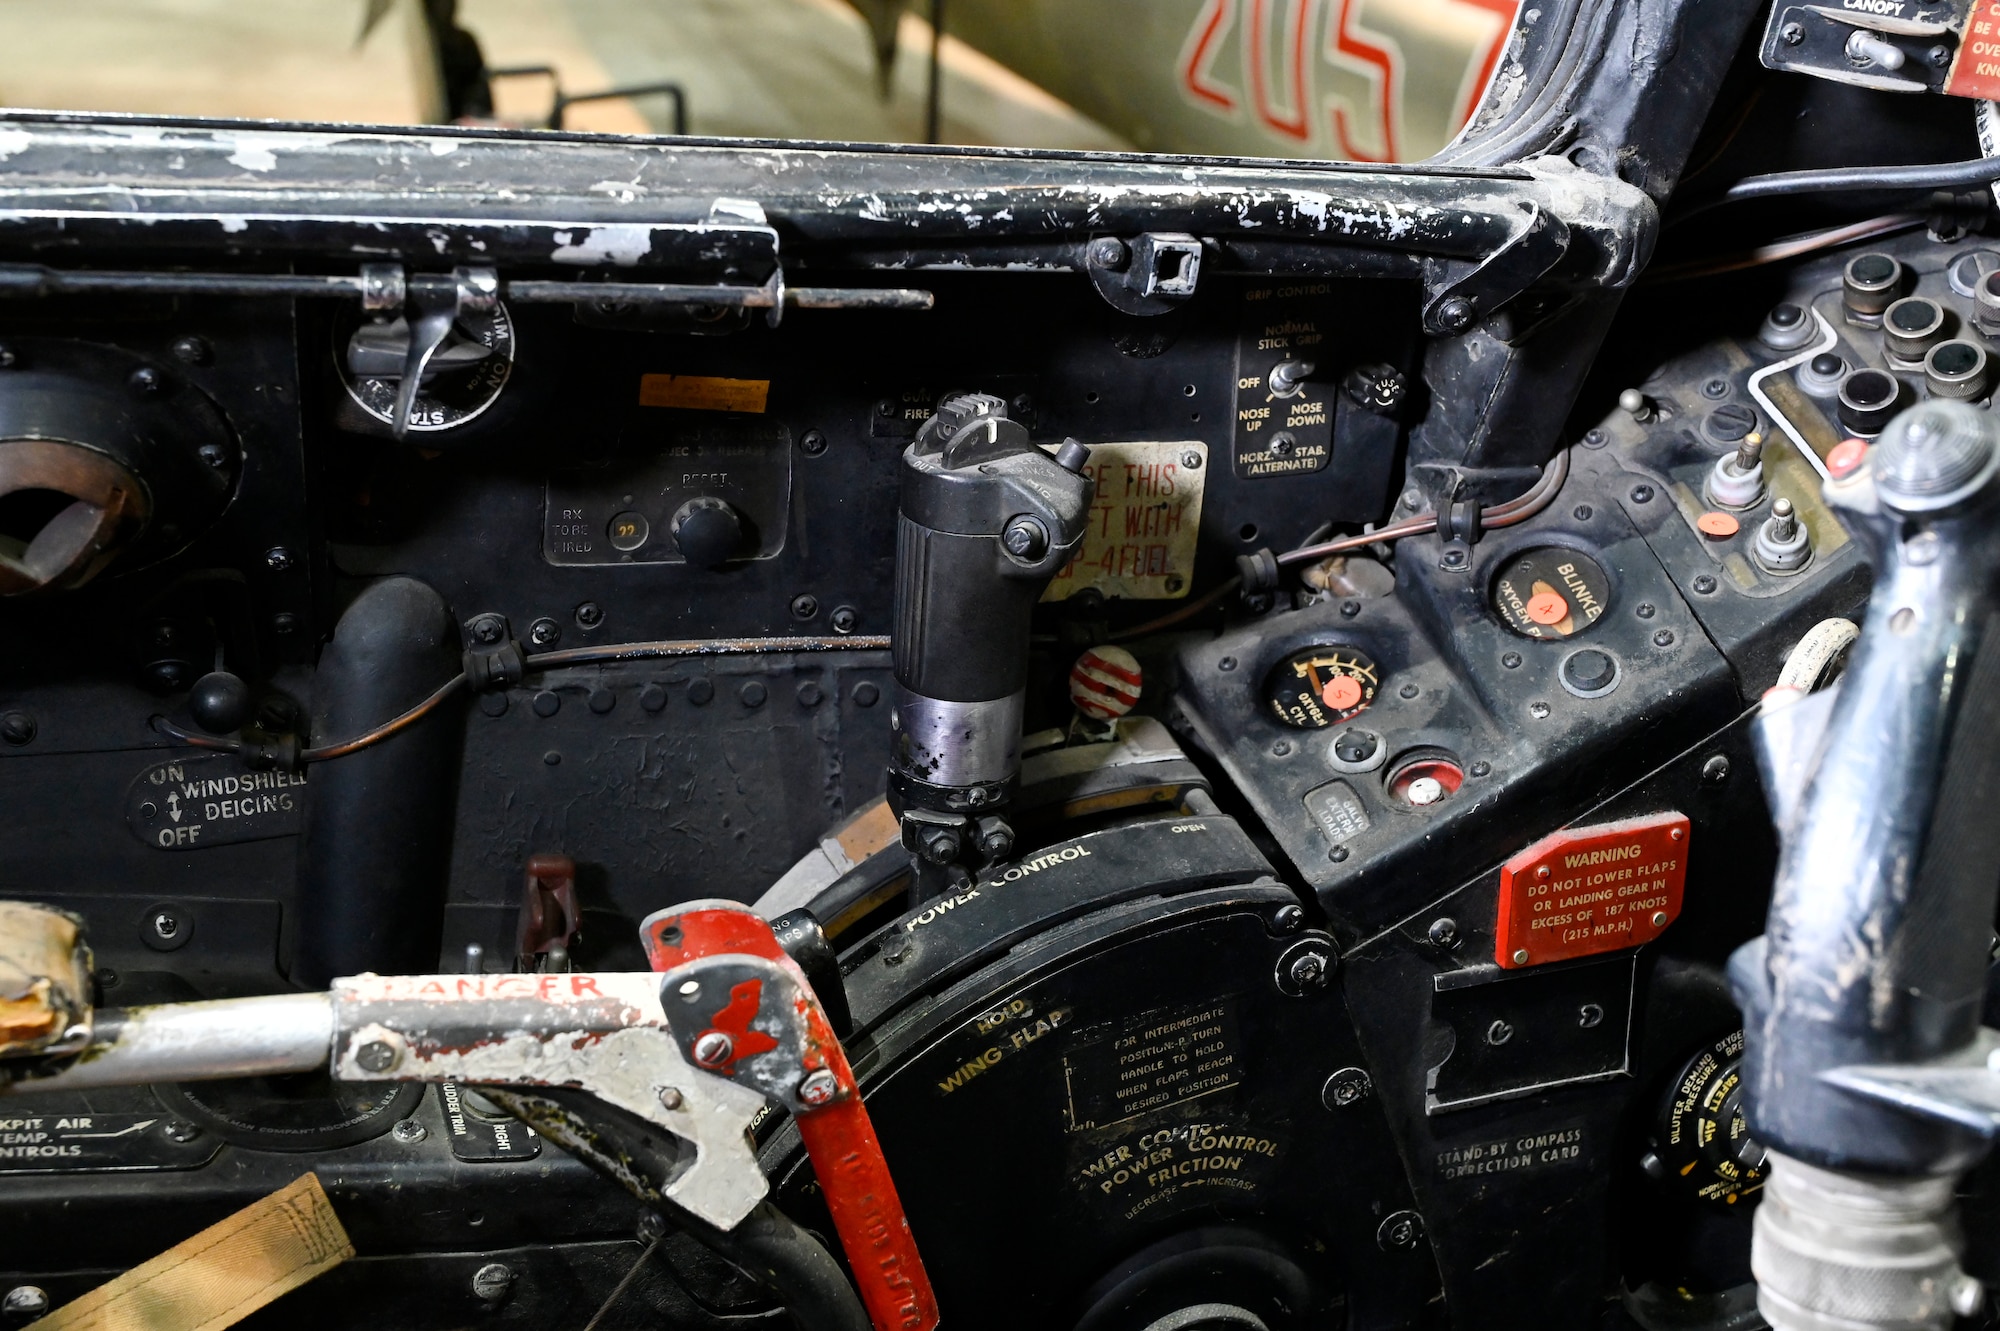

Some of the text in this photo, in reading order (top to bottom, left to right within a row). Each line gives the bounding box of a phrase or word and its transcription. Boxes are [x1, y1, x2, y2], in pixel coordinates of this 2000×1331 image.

[1974, 21, 1992, 35] BE
[1246, 283, 1332, 302] GRIP CONTROL
[1265, 321, 1316, 336] NORMAL
[1258, 334, 1323, 350] STICK GRIP
[1238, 377, 1261, 389] OFF
[1375, 379, 1400, 394] FUSE
[902, 391, 932, 403] GUN
[1291, 402, 1323, 415] NOSE
[381, 404, 444, 425] STAT
[904, 408, 931, 420] FIRE
[1239, 407, 1271, 421] NOSE
[1246, 421, 1262, 432] UP
[1287, 414, 1326, 428] DOWN
[912, 459, 934, 474] OUT
[1239, 445, 1326, 465] HORZ. STAB.
[1247, 456, 1317, 476] (ALTERNATE)
[1124, 463, 1177, 498] THIS
[562, 508, 583, 520] RX
[1126, 502, 1182, 538] WITH
[1557, 562, 1602, 623] BLINKE
[1290, 705, 1308, 726] CYL
[1298, 692, 1329, 727] OXYGEN
[150, 765, 185, 785] ON
[205, 792, 294, 821] DEICING
[158, 824, 202, 847] OFF
[1171, 822, 1206, 834] OPEN
[1564, 844, 1642, 869] WARNING
[906, 845, 1091, 932] POWER CONTROL
[1527, 860, 1677, 897] DO NOT LOWER FLAPS
[1533, 879, 1666, 912] OR LANDING GEAR IN
[1531, 895, 1668, 930] EXCESS OF 187 KNOTS
[1562, 917, 1634, 944] (215 M.P.H.)
[976, 999, 1025, 1035] HOLD
[1114, 1035, 1137, 1050] FOR
[1144, 1006, 1225, 1040] INTERMEDIATE
[1192, 1025, 1223, 1042] TURN
[937, 1046, 1003, 1093] WING
[1010, 1010, 1063, 1049] FLAP
[1120, 1041, 1225, 1081] HANDLE TO HOLD
[1115, 1054, 1233, 1100] WHEN FLAPS REACH
[1683, 1058, 1719, 1113] PRESSURE
[1124, 1072, 1229, 1114] DESIRED POSITION
[1670, 1052, 1713, 1146] DILUTER DEMAND
[1708, 1073, 1739, 1114] SAFETY
[55, 1117, 93, 1130] AIR
[451, 1113, 467, 1136] TRIM
[749, 1105, 772, 1131] IGN.
[493, 1124, 512, 1151] RIGHT
[1436, 1128, 1582, 1166] STAND-BY COMPASS
[1099, 1135, 1279, 1195] POWER CONTROL
[1147, 1154, 1244, 1188] FRICTION
[1441, 1144, 1580, 1180] ORRECTION CARD
[1124, 1176, 1257, 1220] DECREASE INCREASE
